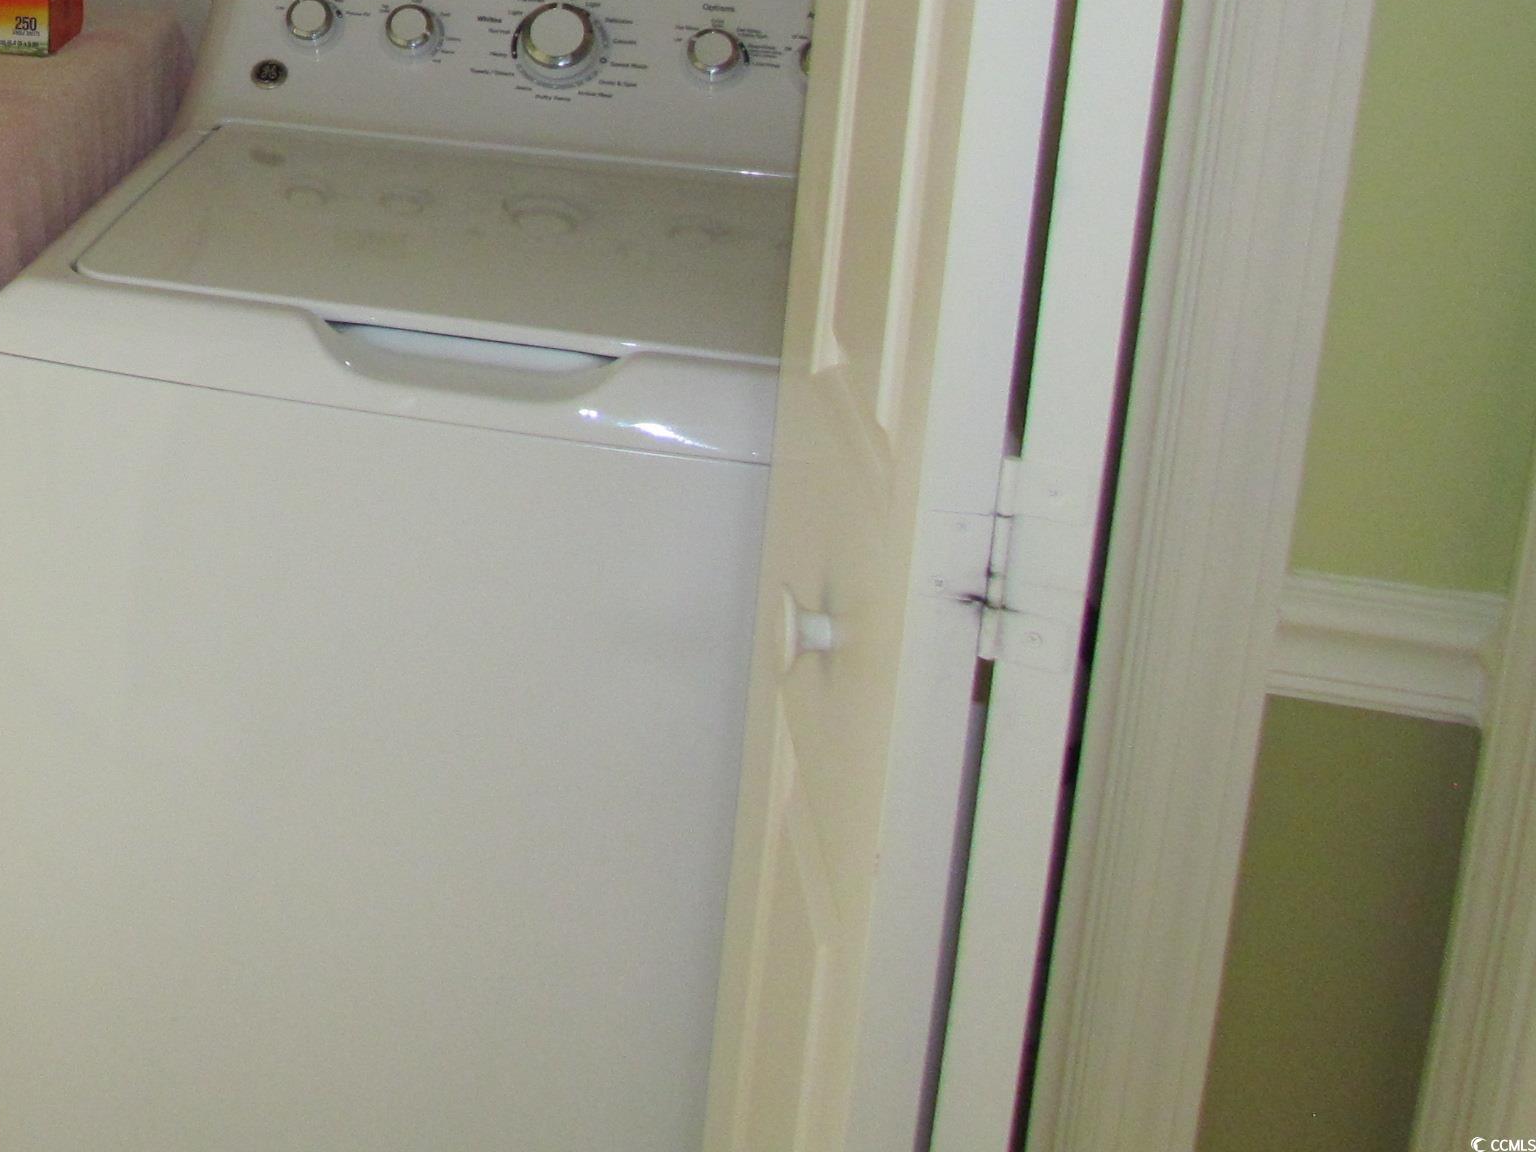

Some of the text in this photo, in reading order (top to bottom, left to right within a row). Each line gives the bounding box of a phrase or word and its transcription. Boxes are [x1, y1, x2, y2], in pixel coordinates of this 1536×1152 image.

[702, 2, 736, 13] Options
[15, 16, 37, 31] 250
[477, 15, 502, 24] Whites
